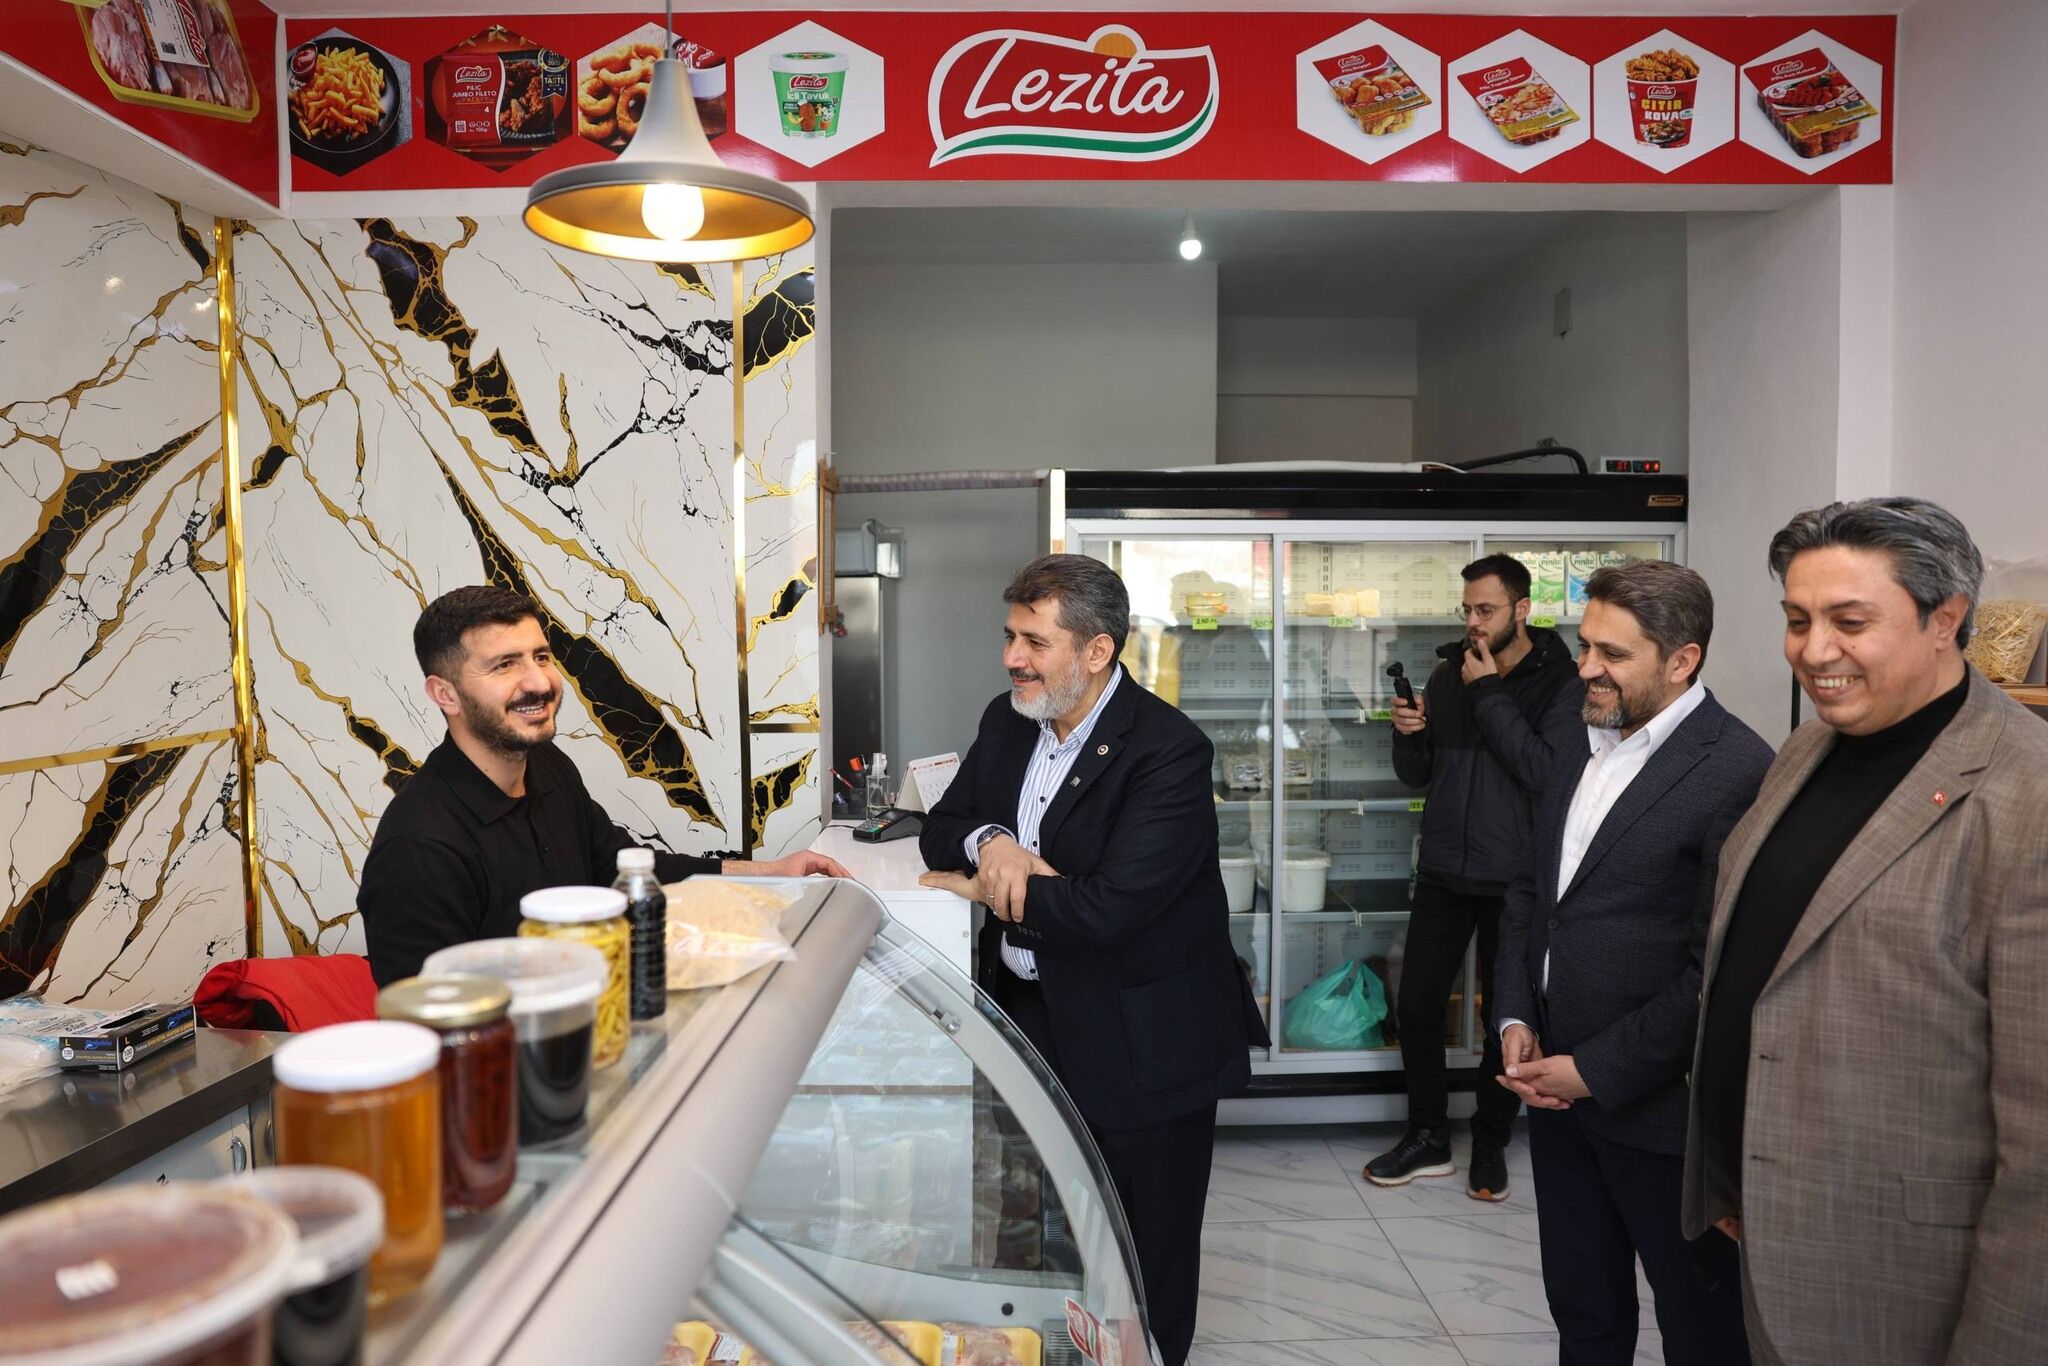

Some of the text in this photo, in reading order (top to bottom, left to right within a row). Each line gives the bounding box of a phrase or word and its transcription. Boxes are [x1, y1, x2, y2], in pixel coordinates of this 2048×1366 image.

[459, 67, 488, 79] Lezita
[964, 36, 1185, 119] Lezita
[544, 77, 565, 85] TASTE
[793, 76, 824, 87] Lezita
[801, 92, 830, 100] Tavuk
[1644, 111, 1680, 121] KOVA
[65, 1037, 71, 1047] L
